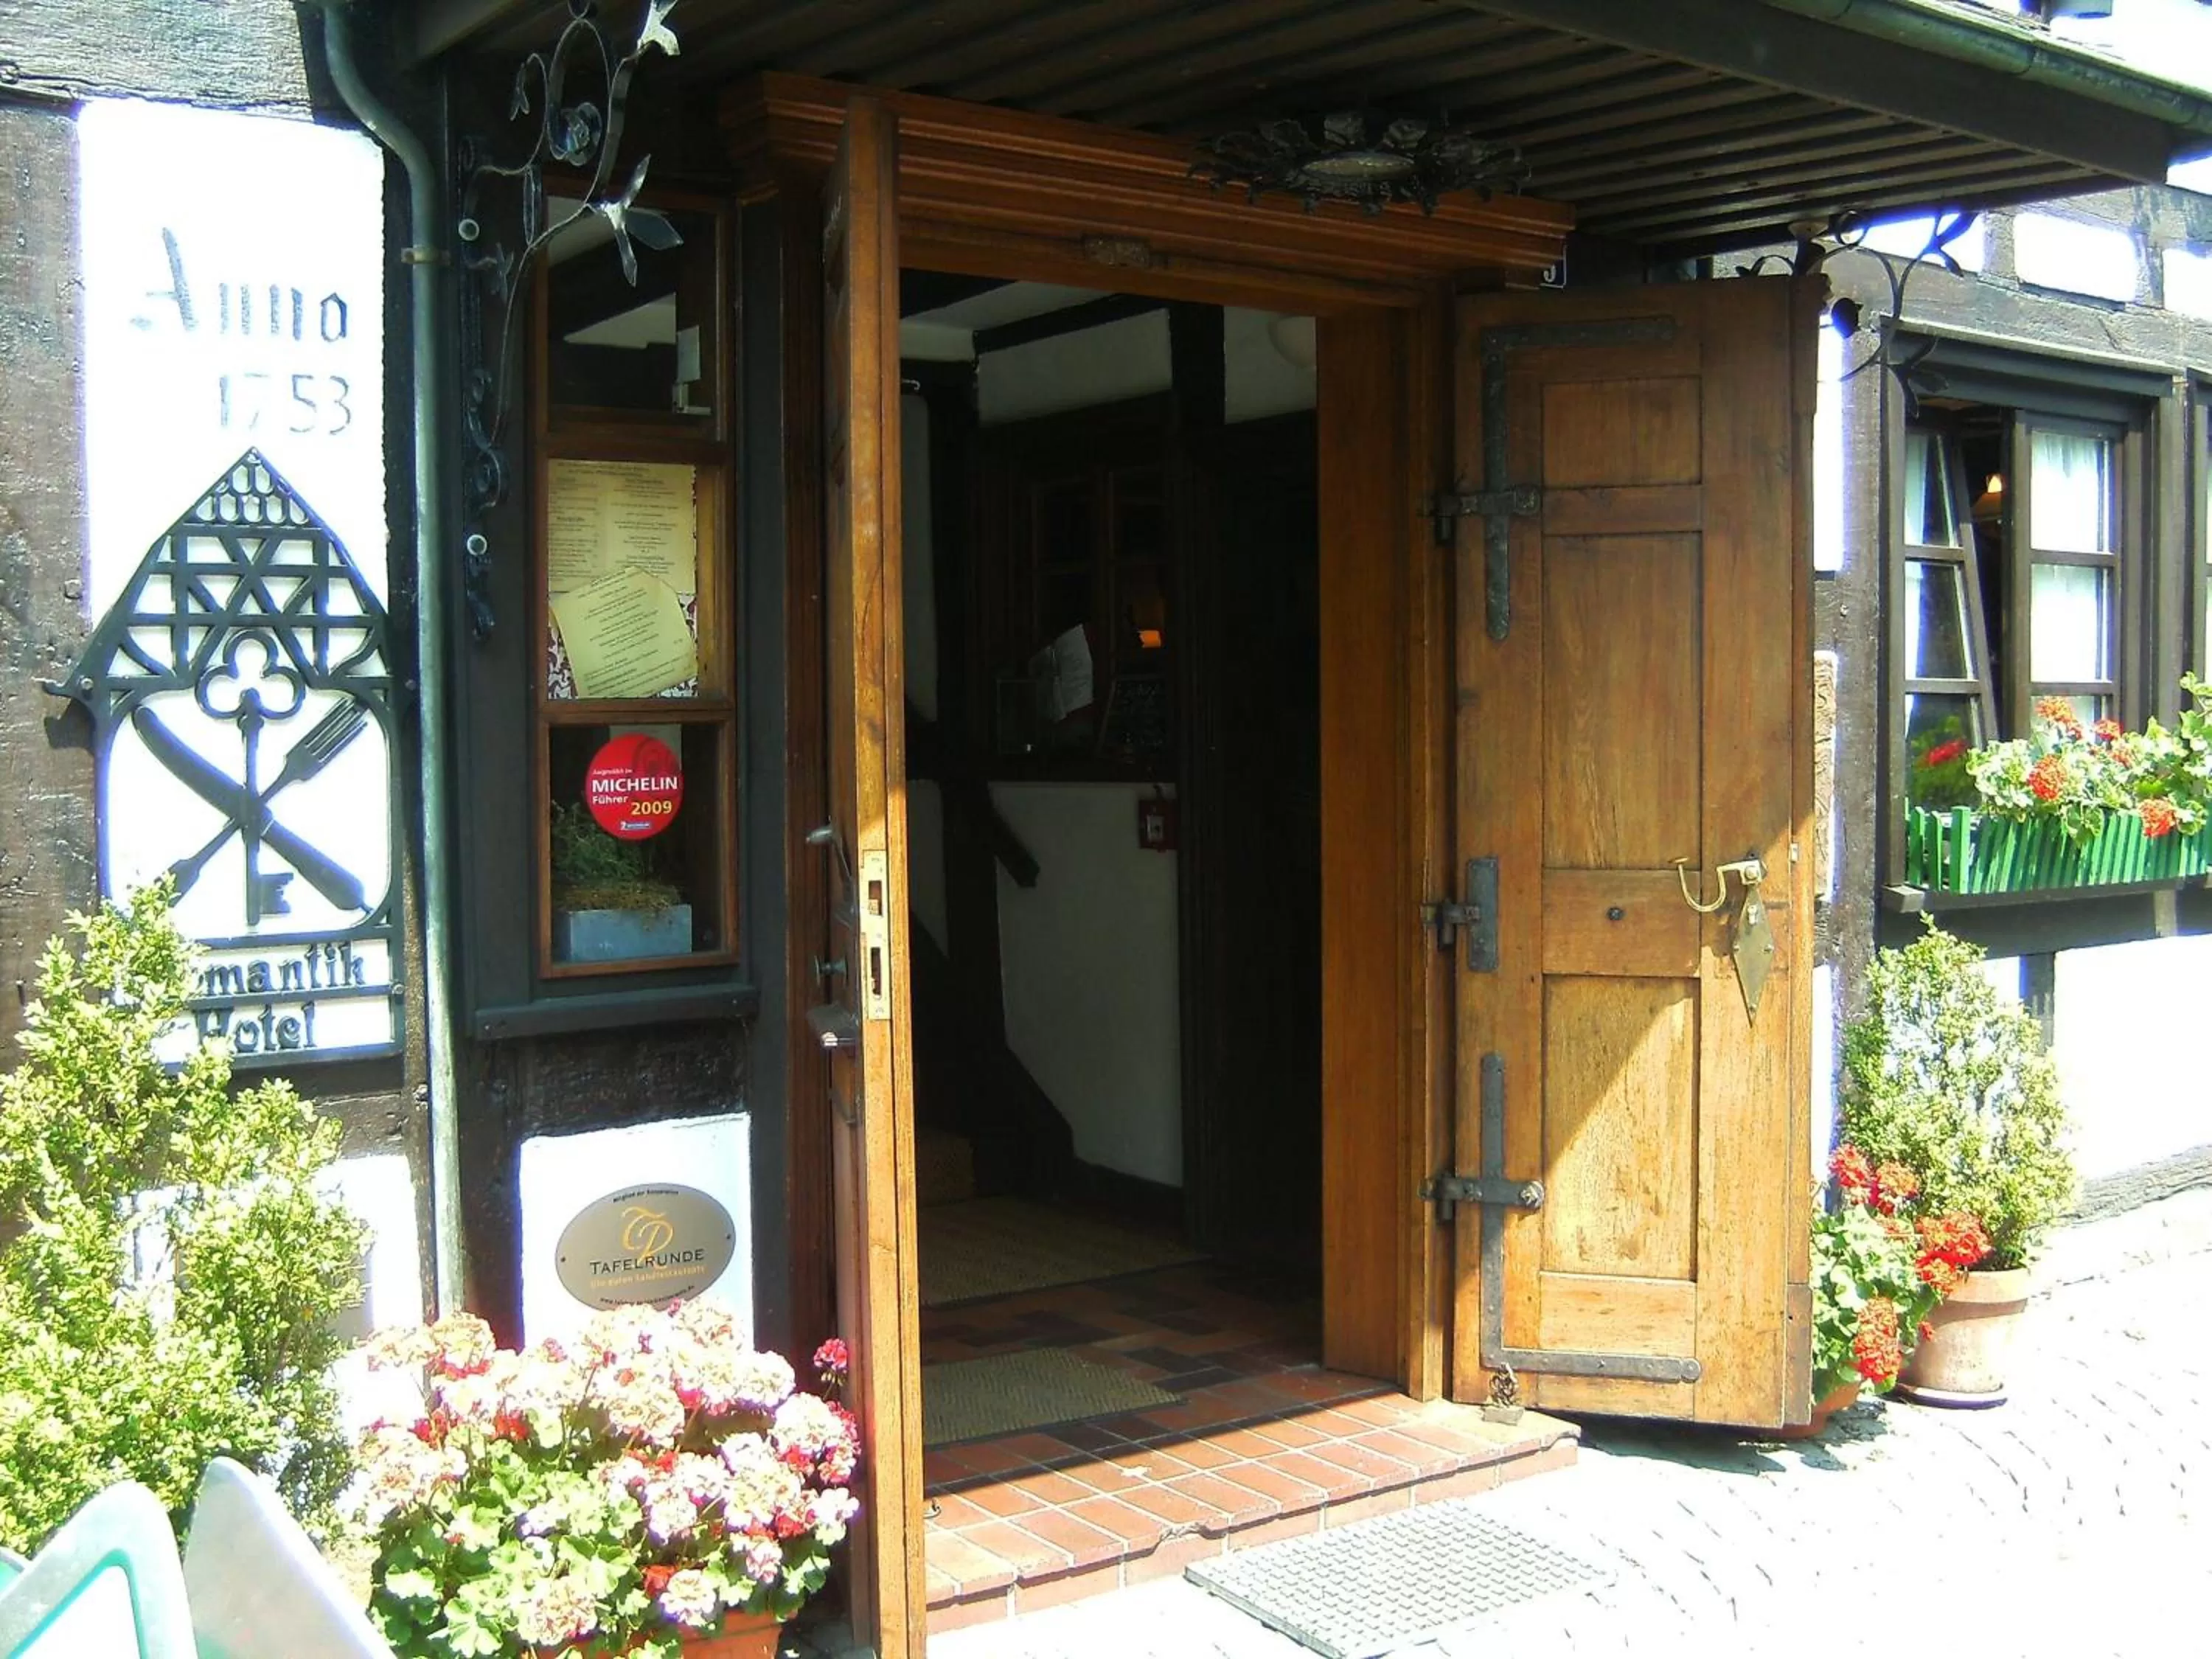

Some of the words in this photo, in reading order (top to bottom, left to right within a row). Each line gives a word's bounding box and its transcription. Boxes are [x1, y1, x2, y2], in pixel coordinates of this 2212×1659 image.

[130, 226, 348, 342] Anno
[219, 373, 352, 435] 1753
[592, 776, 678, 793] MICHELIN
[592, 794, 629, 805] Führer
[631, 800, 673, 815] 2009
[190, 942, 366, 997] mantik
[193, 1001, 317, 1053] Hotel
[589, 1248, 706, 1276] TAFELRUNDE
